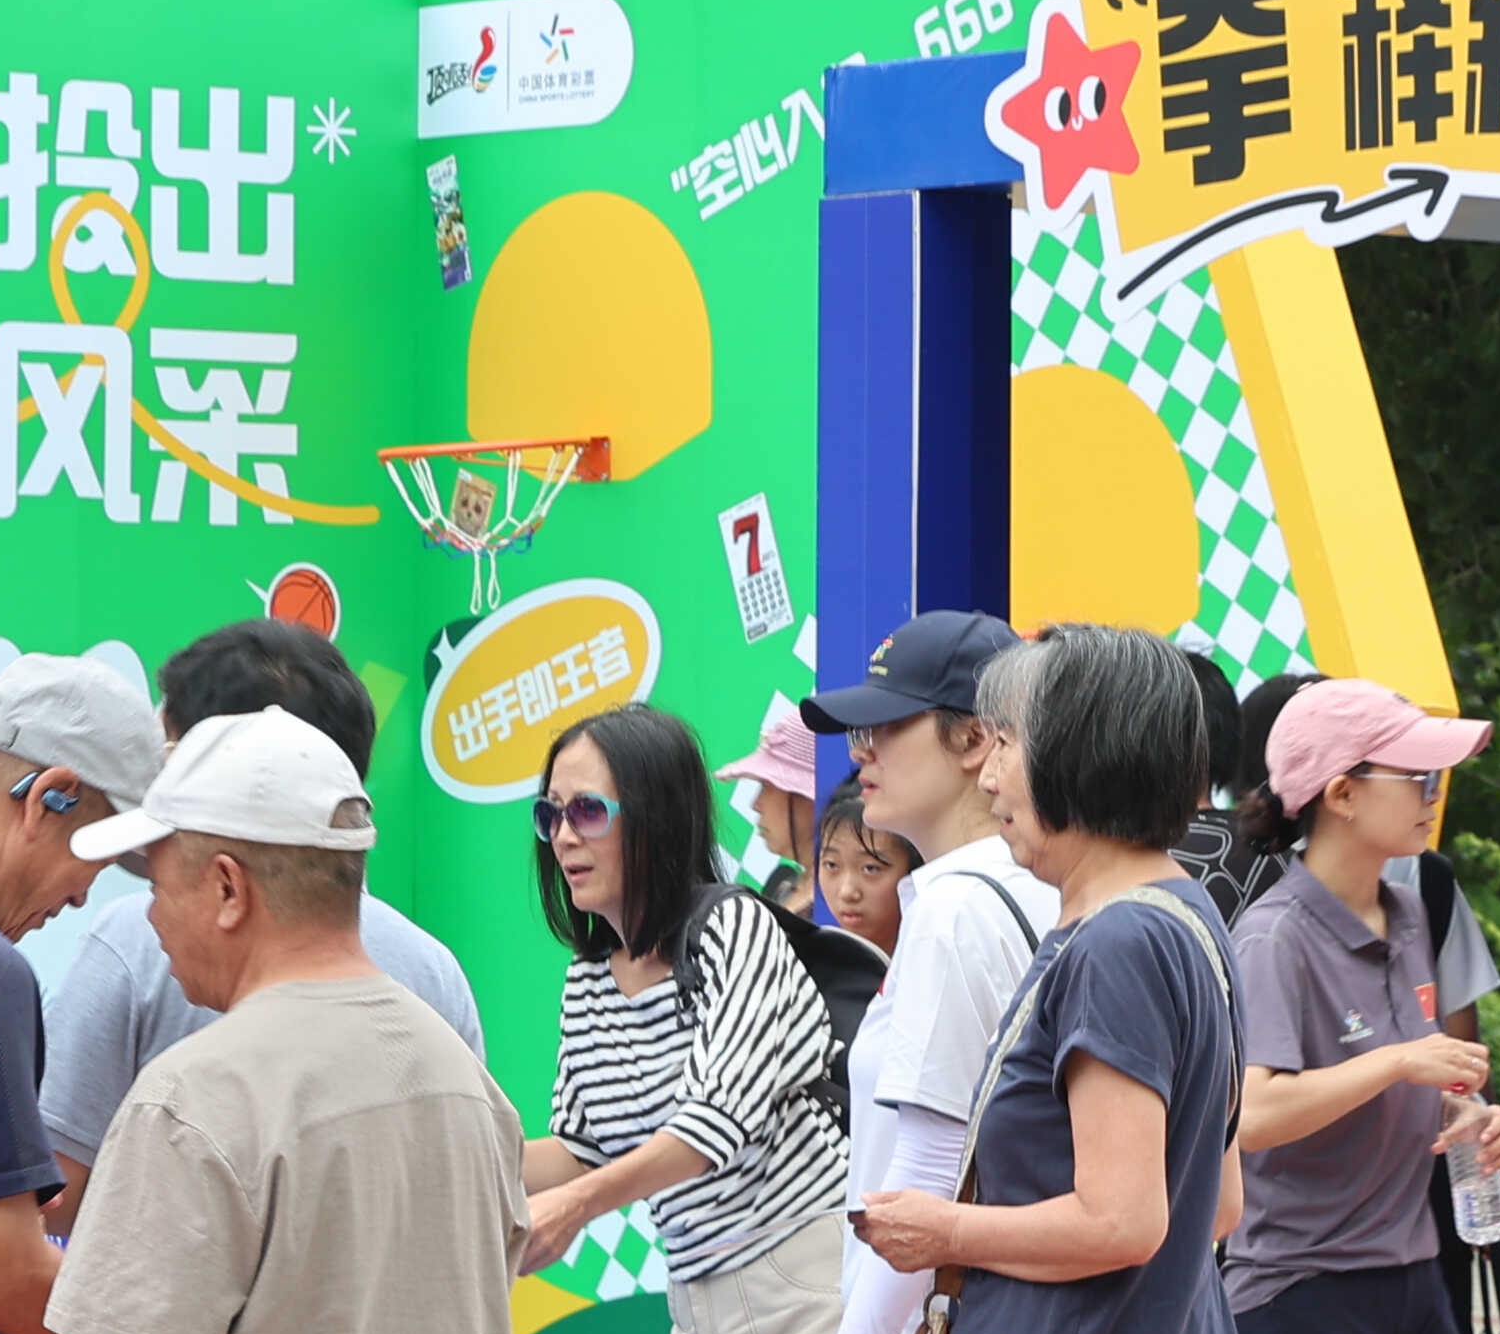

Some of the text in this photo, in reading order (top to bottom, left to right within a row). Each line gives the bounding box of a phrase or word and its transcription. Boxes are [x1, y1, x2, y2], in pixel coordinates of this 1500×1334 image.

[519, 70, 595, 91] 中国体育彩票
[734, 511, 762, 577] 7
[448, 624, 633, 763] 出手即王者
